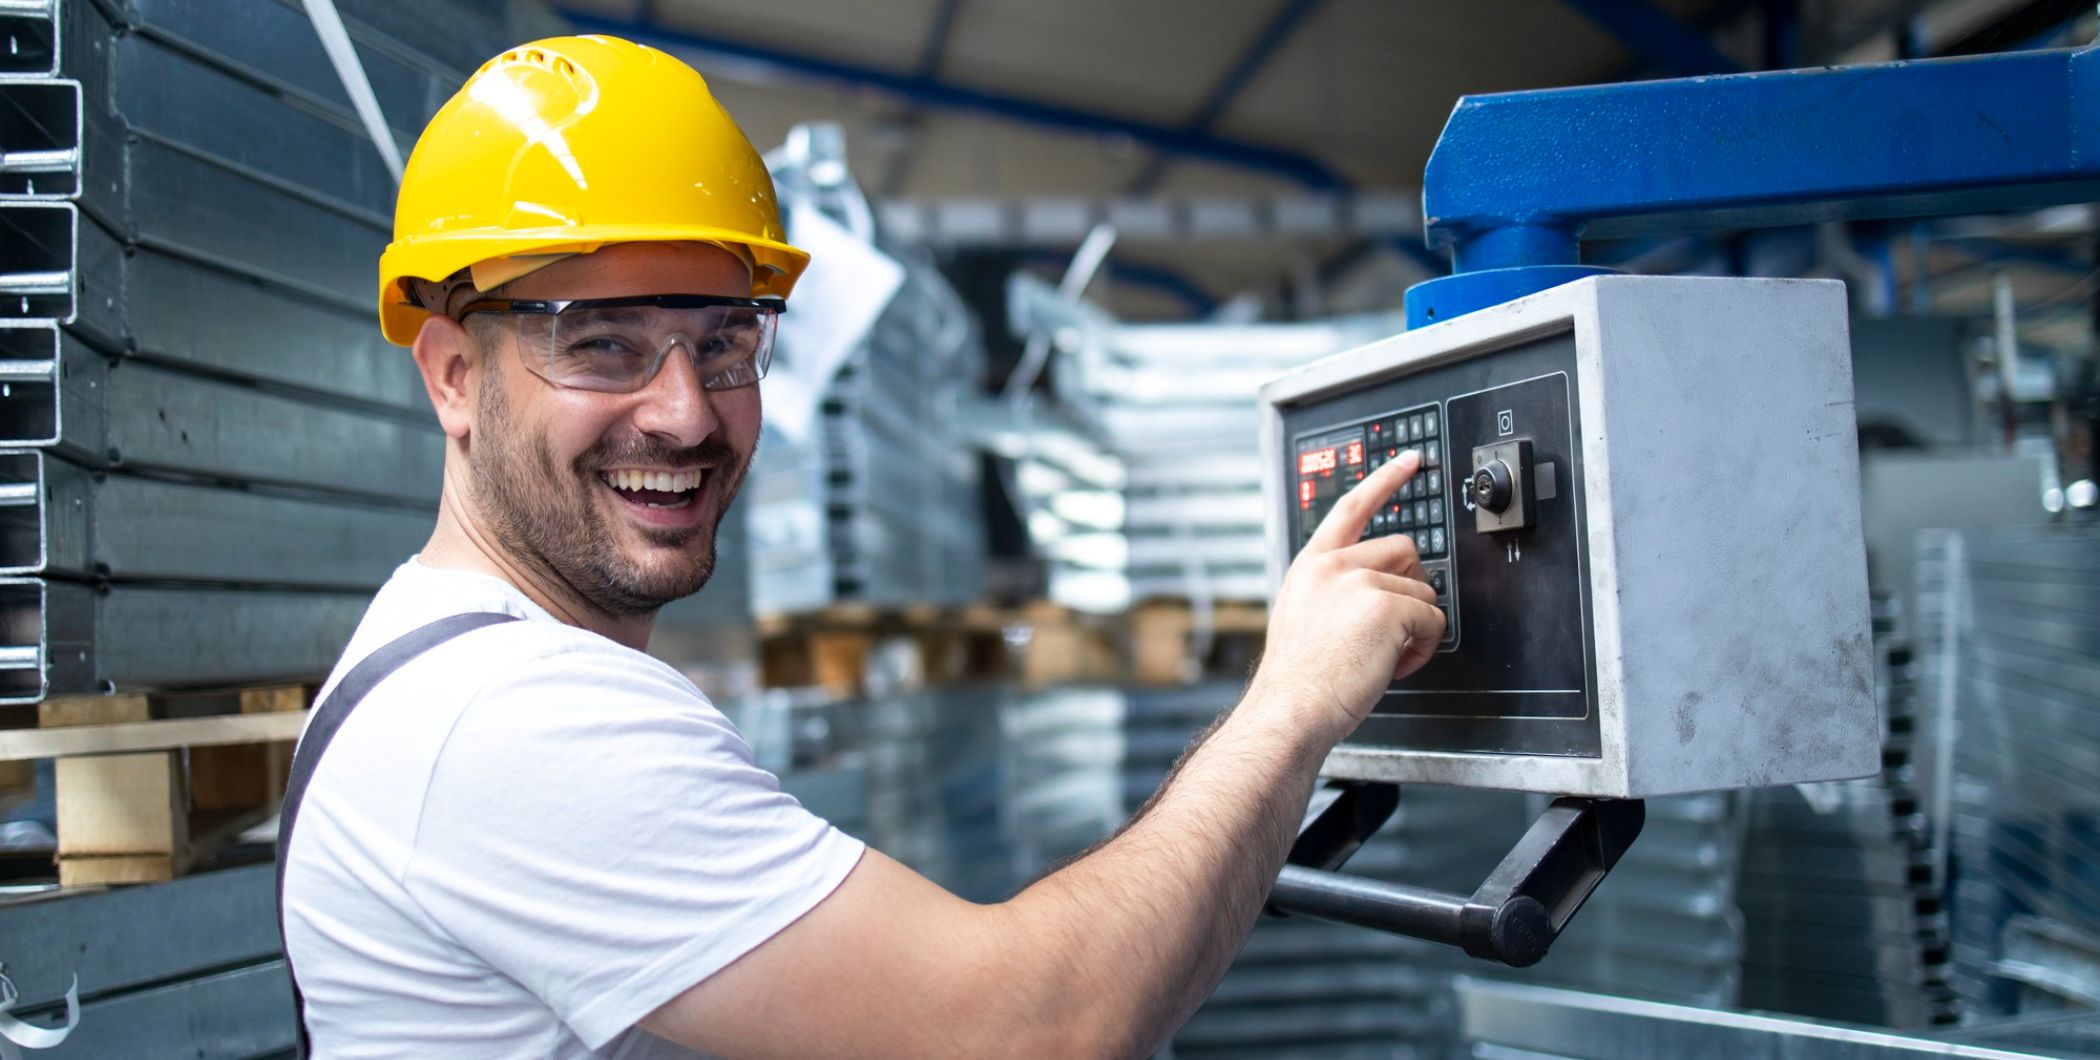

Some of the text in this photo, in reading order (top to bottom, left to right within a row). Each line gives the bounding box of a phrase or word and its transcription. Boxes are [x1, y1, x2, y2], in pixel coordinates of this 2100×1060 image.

[1397, 423, 1405, 438] 7
[1428, 417, 1434, 431] 9
[1430, 446, 1436, 460] 6
[1416, 478, 1423, 491] 2
[1430, 474, 1437, 489] 3
[1418, 536, 1426, 549] C
